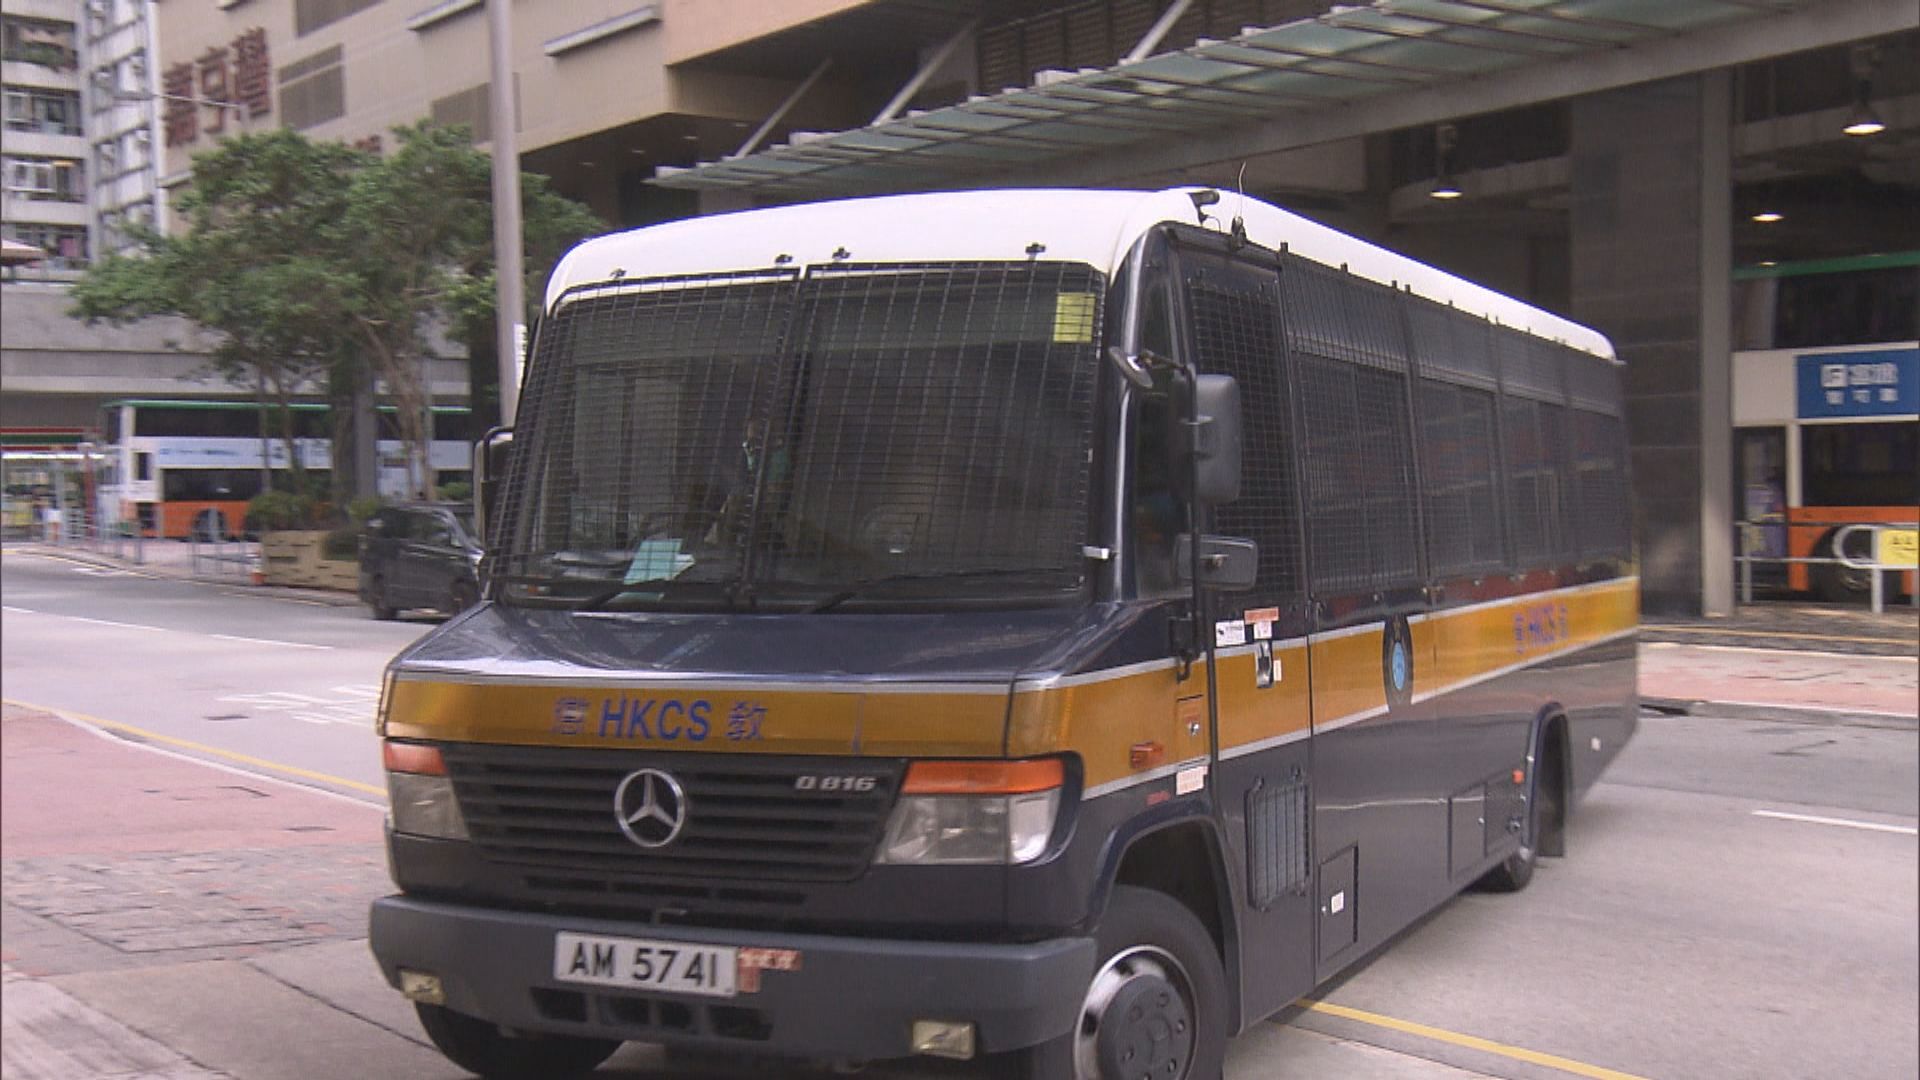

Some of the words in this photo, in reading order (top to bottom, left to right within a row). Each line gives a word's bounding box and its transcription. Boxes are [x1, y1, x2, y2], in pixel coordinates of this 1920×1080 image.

[599, 698, 711, 741] HKCS
[819, 775, 877, 791] 816
[570, 942, 616, 977] AM
[632, 947, 718, 988] 5741
